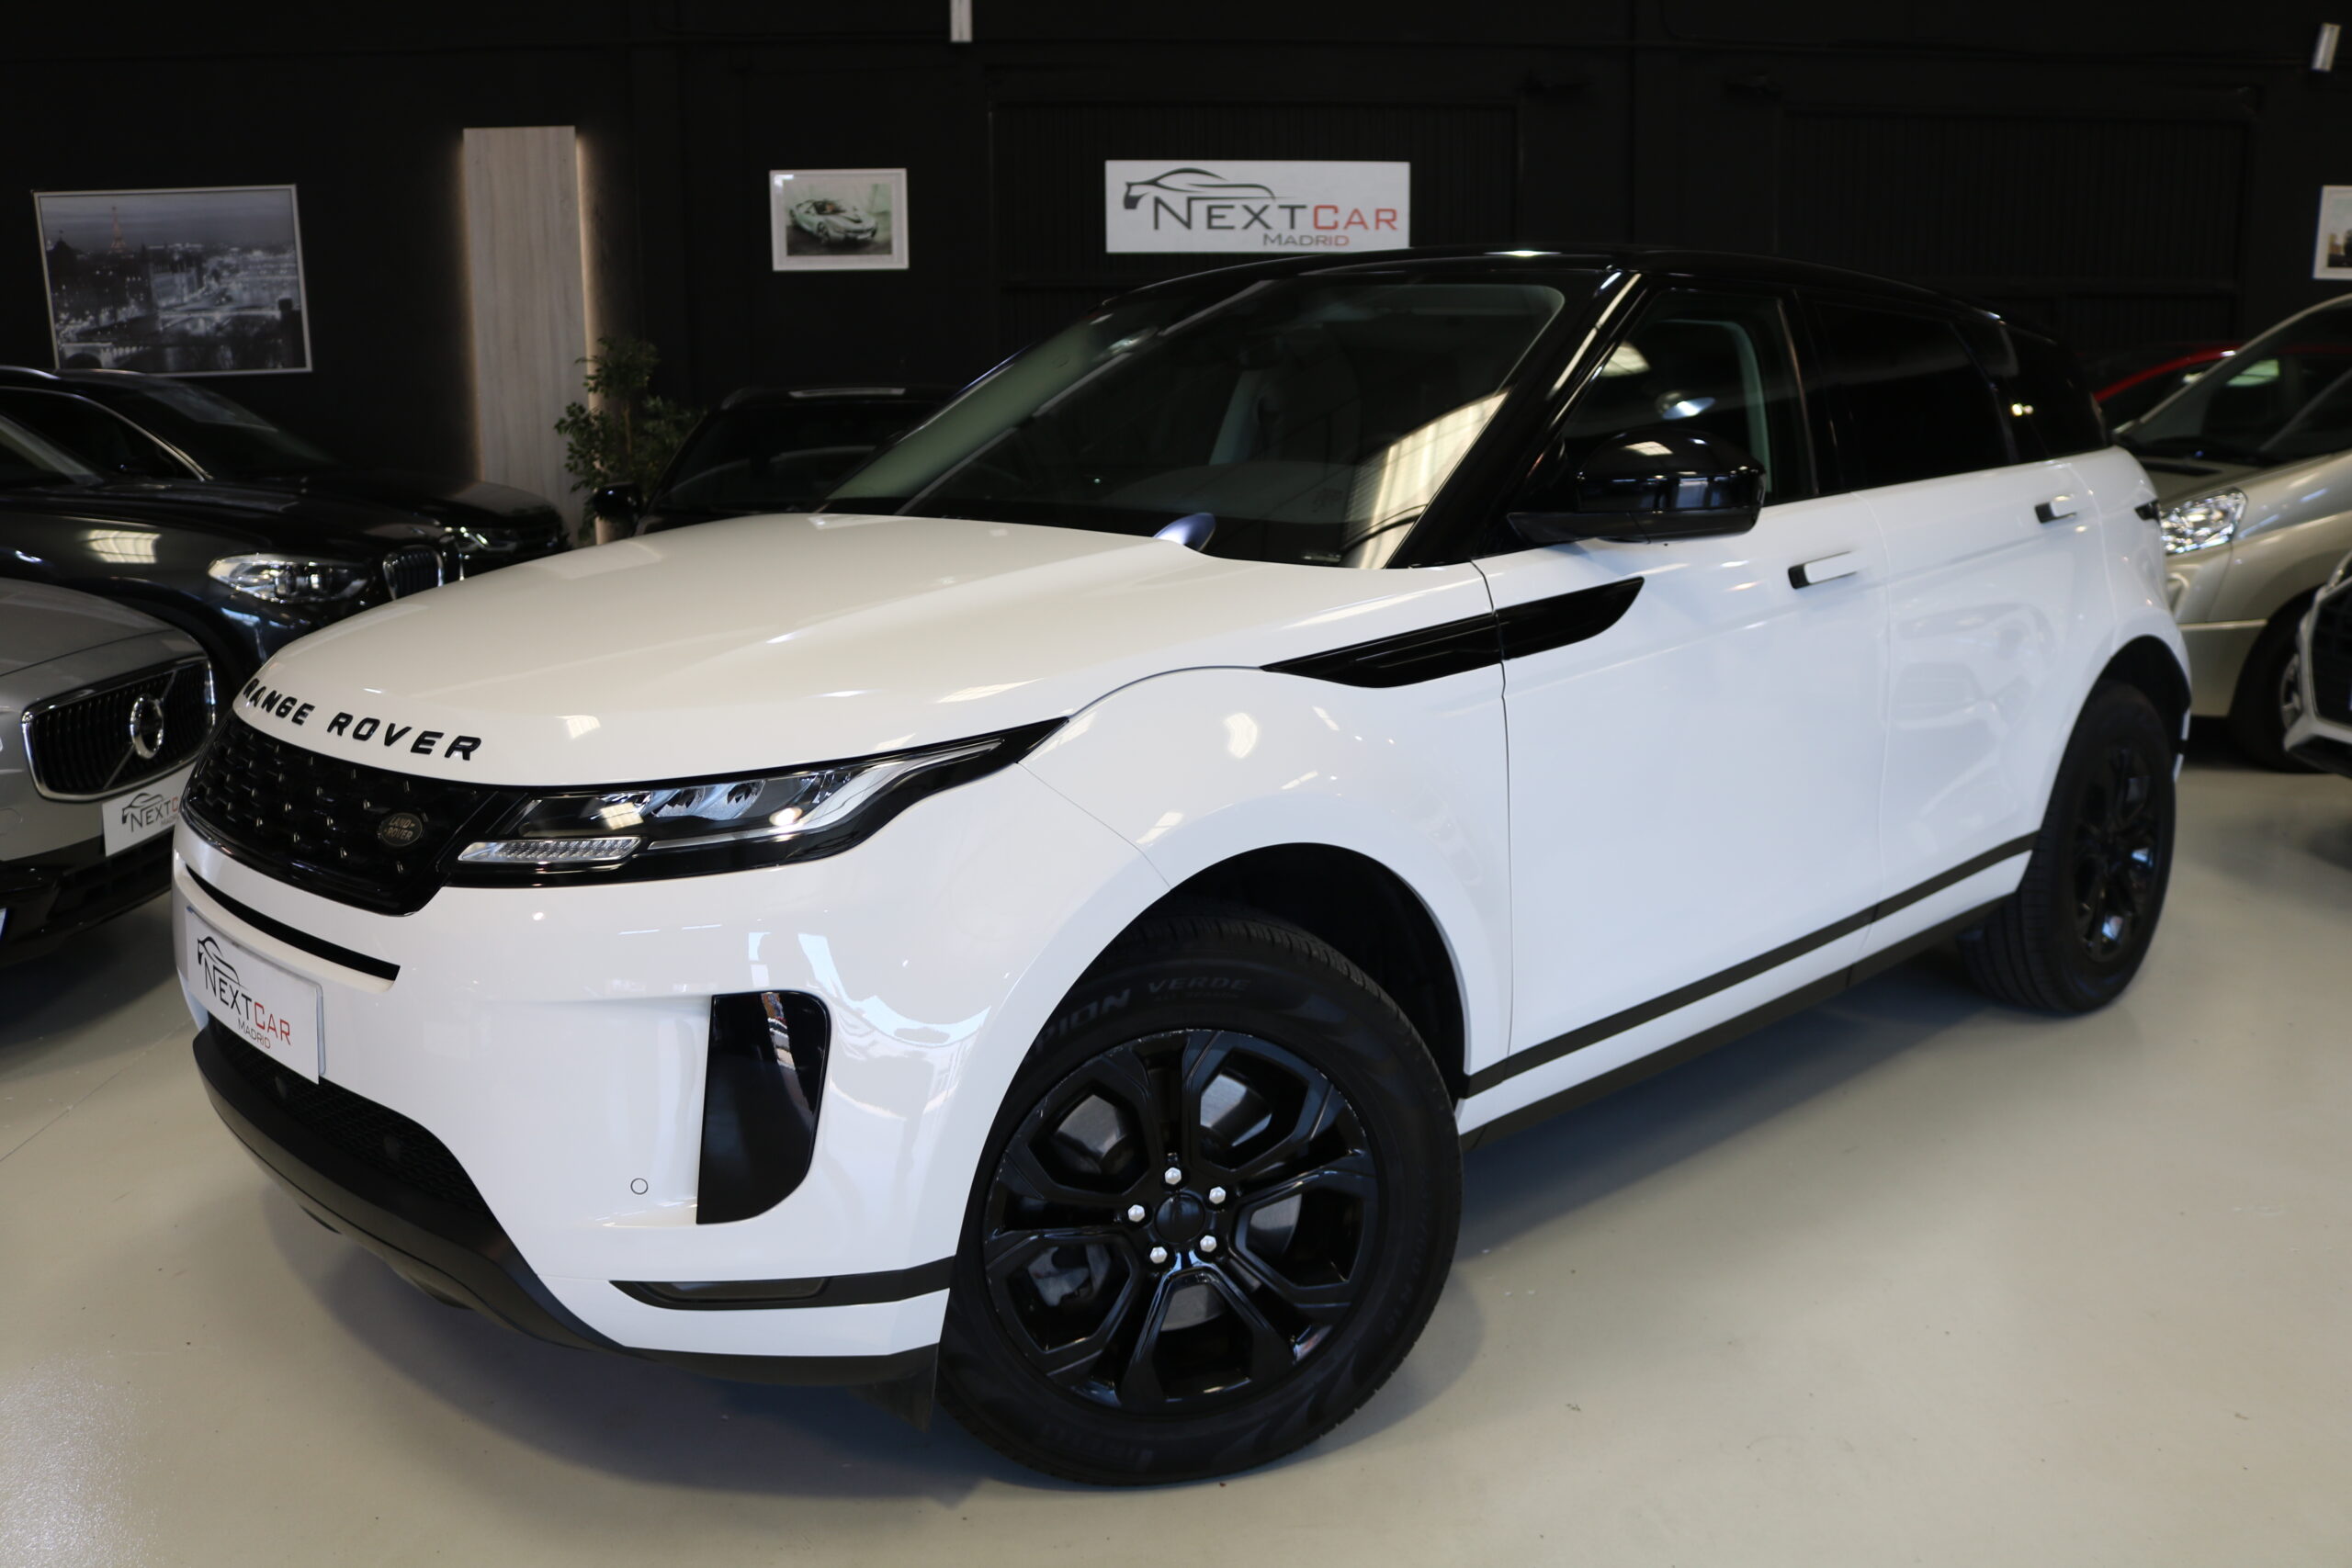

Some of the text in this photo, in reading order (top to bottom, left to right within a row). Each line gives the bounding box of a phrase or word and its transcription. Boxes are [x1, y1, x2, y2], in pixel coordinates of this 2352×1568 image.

[1154, 195, 1398, 231] NEXTCAR
[1262, 232, 1350, 247] MADRID
[243, 678, 482, 761] RANGE ROVER
[204, 956, 291, 1045] NEXTCAR
[1148, 976, 1252, 993] VERDE
[237, 1018, 271, 1049] MADRID
